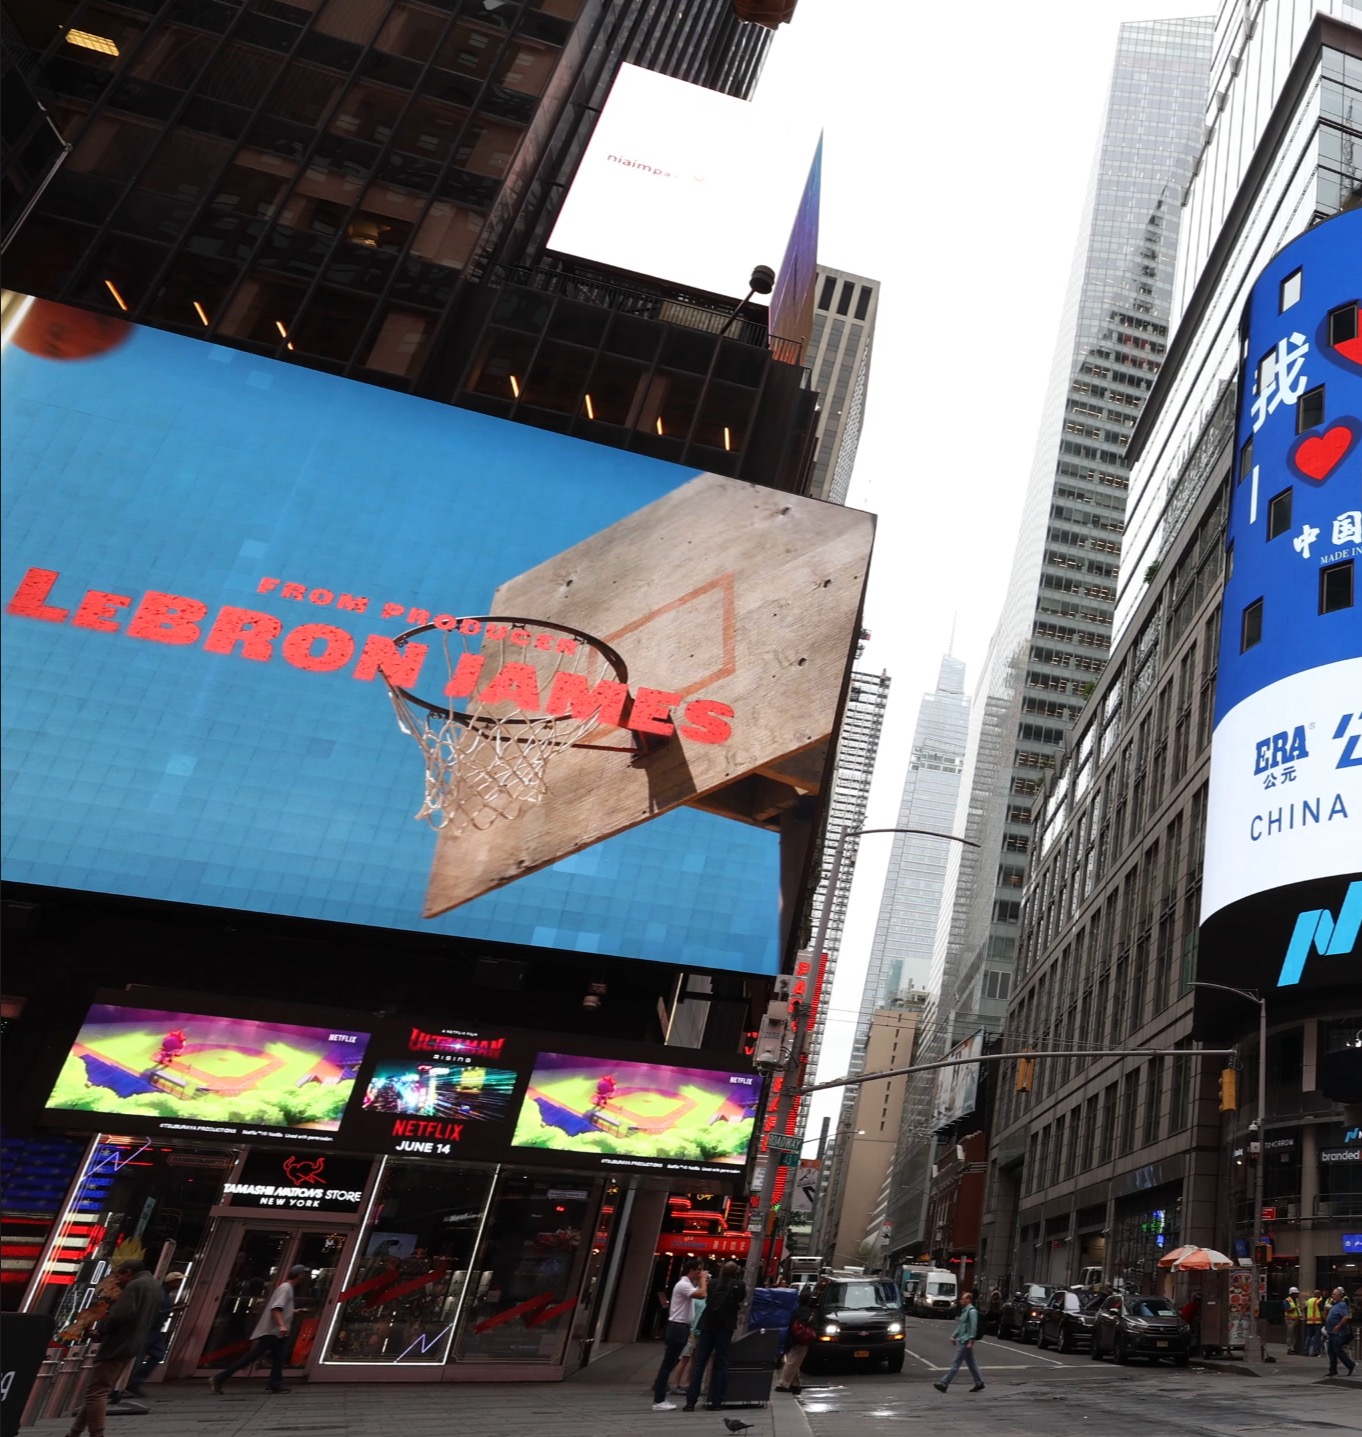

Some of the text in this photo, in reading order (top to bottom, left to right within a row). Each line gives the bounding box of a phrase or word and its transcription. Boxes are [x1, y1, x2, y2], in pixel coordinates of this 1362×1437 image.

[1320, 548, 1349, 565] MADE
[258, 576, 586, 656] FROM PRODUCER
[444, 651, 735, 744] JAMES
[1254, 724, 1309, 776] ERA
[1263, 765, 1297, 790] 公元
[1250, 793, 1349, 842] CHINA
[328, 1033, 357, 1043] NETFLIX
[408, 1027, 506, 1060] ULTRAMAN
[433, 1054, 471, 1063] RISING
[729, 1076, 753, 1085] NETFLIX
[392, 1119, 464, 1141] NETFLIX
[395, 1140, 451, 1155] JUNE 14
[260, 1197, 321, 1208] NEW YORK
[275, 1186, 323, 1198] NATIONS
[325, 1190, 362, 1203] STORE
